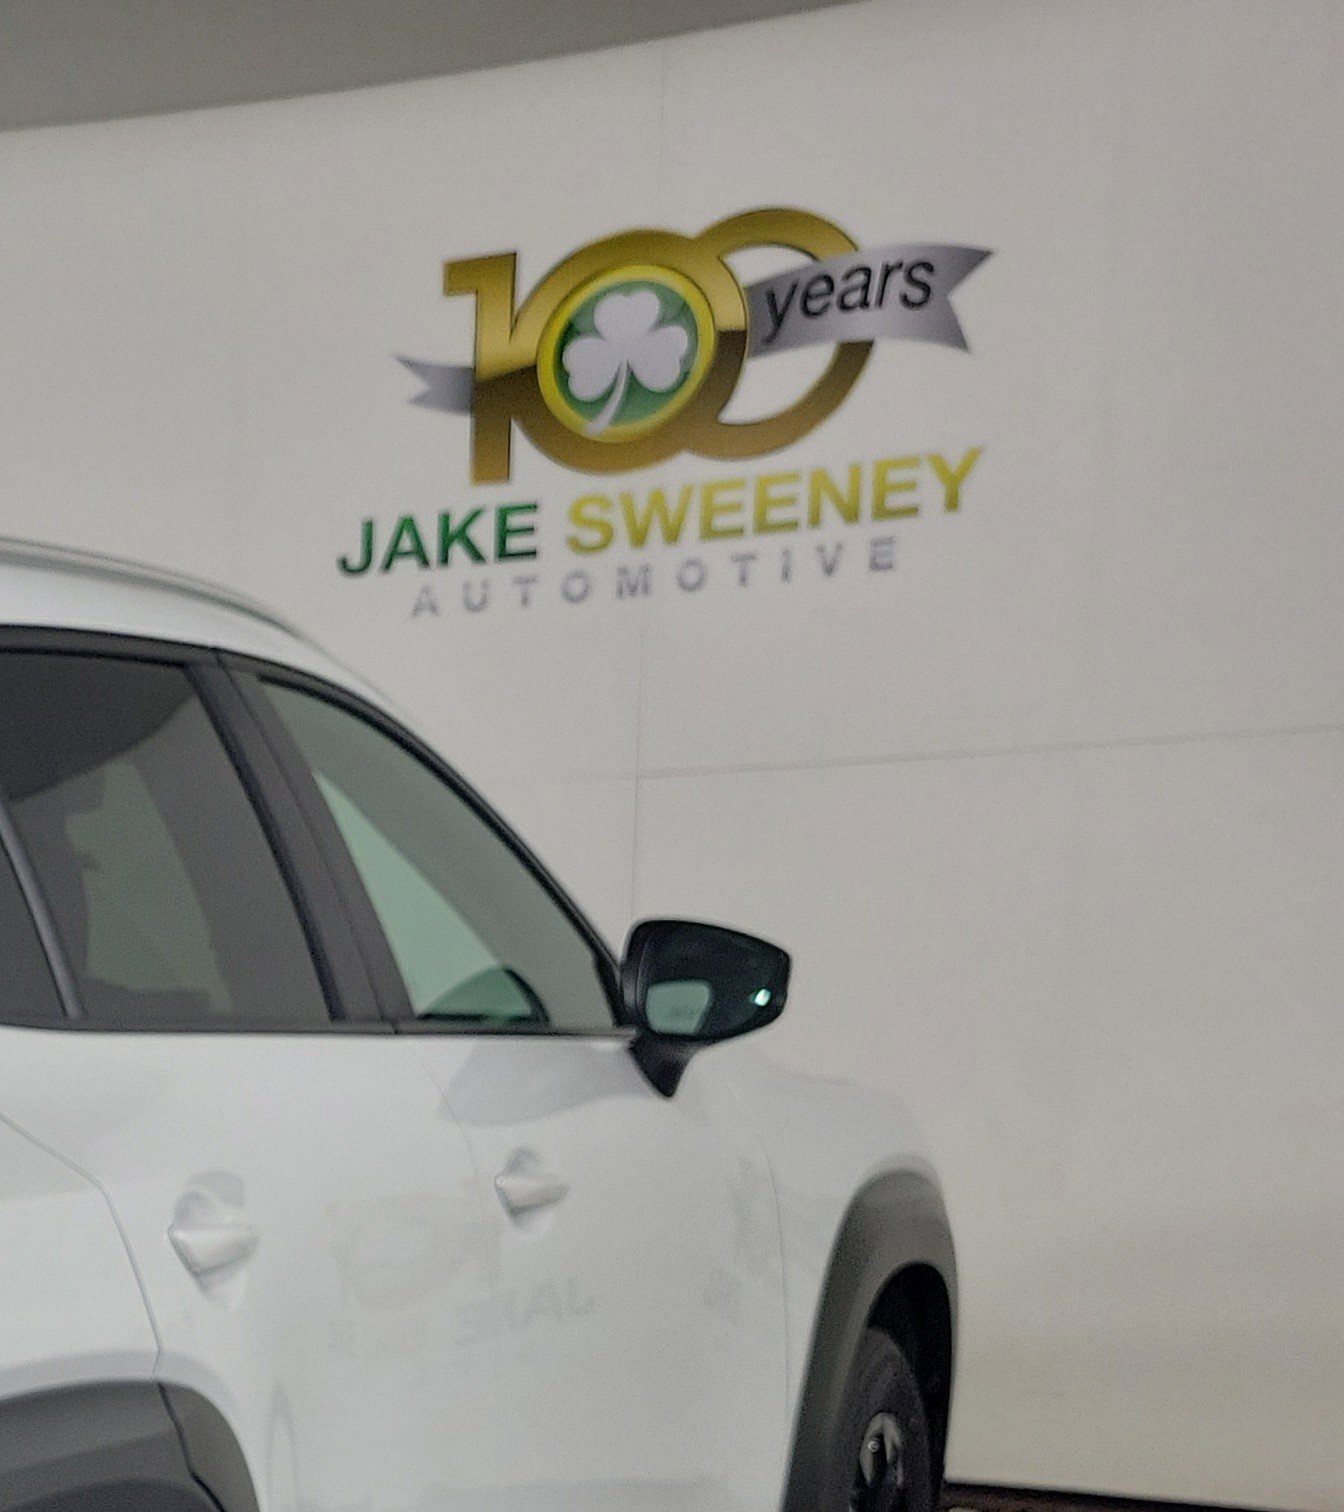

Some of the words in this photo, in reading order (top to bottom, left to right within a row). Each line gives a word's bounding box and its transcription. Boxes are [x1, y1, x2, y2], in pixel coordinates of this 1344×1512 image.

[762, 254, 935, 346] years
[337, 501, 538, 578] JAKE
[565, 446, 984, 557] SWEENEY
[411, 536, 898, 619] AUTOMOTIVE
